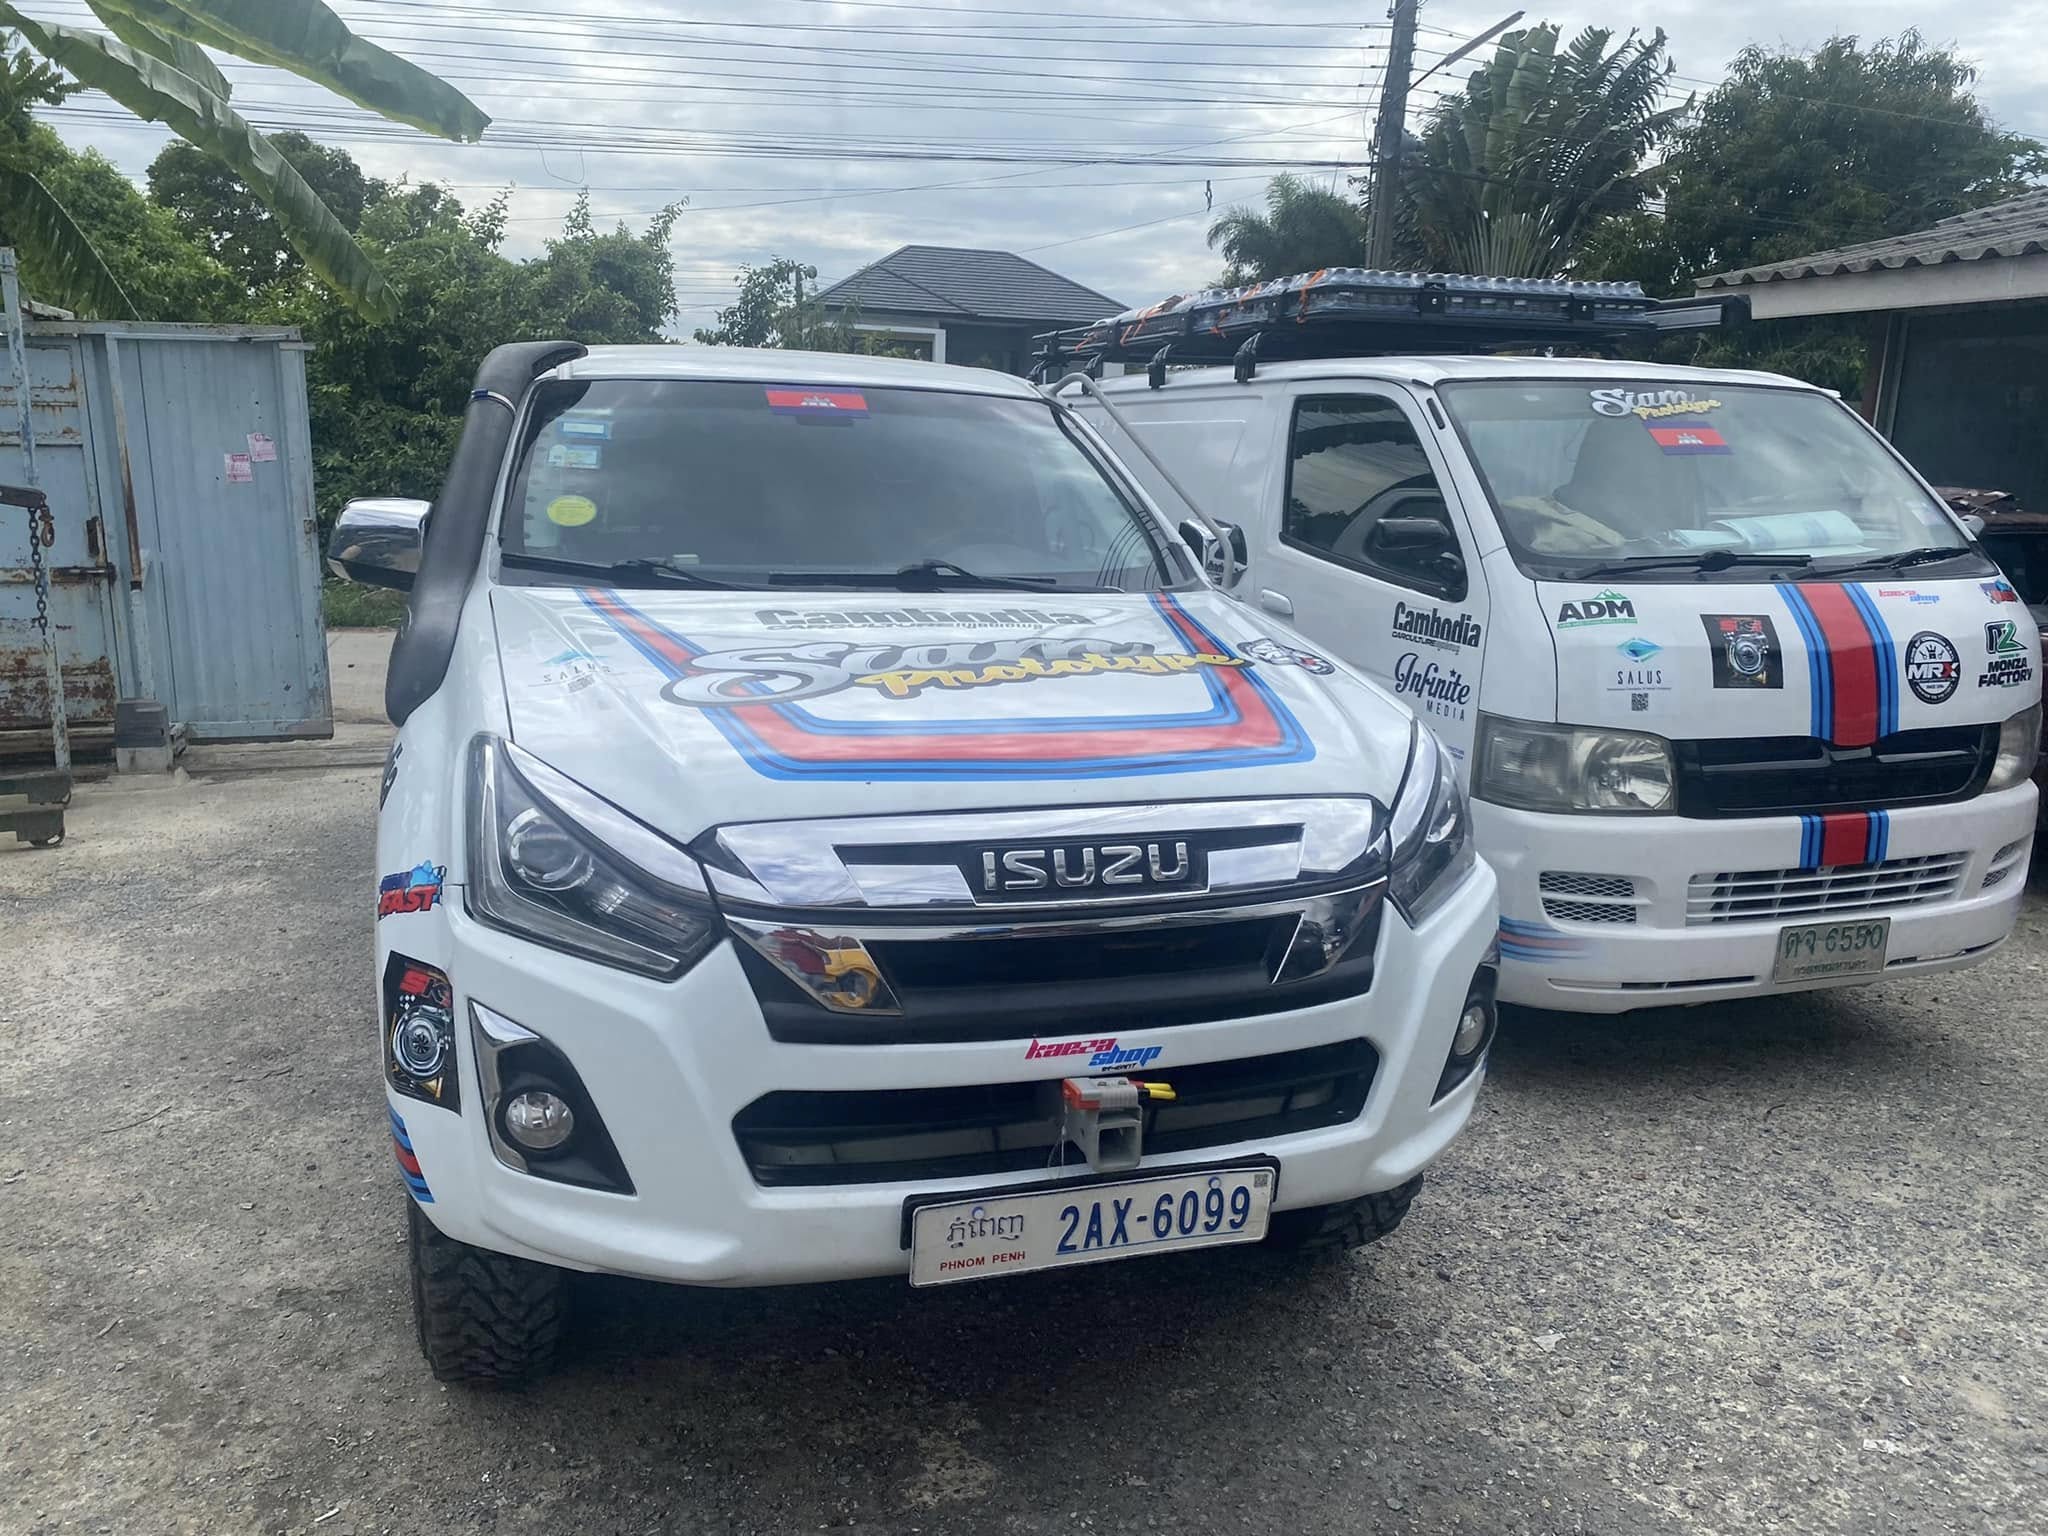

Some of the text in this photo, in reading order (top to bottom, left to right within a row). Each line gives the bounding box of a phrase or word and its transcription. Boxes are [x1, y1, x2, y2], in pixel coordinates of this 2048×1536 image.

[755, 608, 1096, 625] Cambodia
[1558, 600, 1636, 622] ADM
[1392, 601, 1481, 648] Cambodia
[660, 638, 1154, 706] Siam
[1908, 663, 1959, 679] MRX
[1988, 657, 2028, 673] MONZA
[1395, 653, 1471, 705] Infinite
[1617, 670, 1662, 684] SALUS
[1978, 668, 2033, 688] FACTORY
[1426, 699, 1465, 721] MEDIA
[982, 842, 1189, 890] ISUZU
[1825, 924, 1883, 952] 6550
[1088, 1044, 1163, 1068] shop
[1057, 1185, 1250, 1251] 2AX-6099
[939, 1251, 1026, 1271] PHNOM PENH
